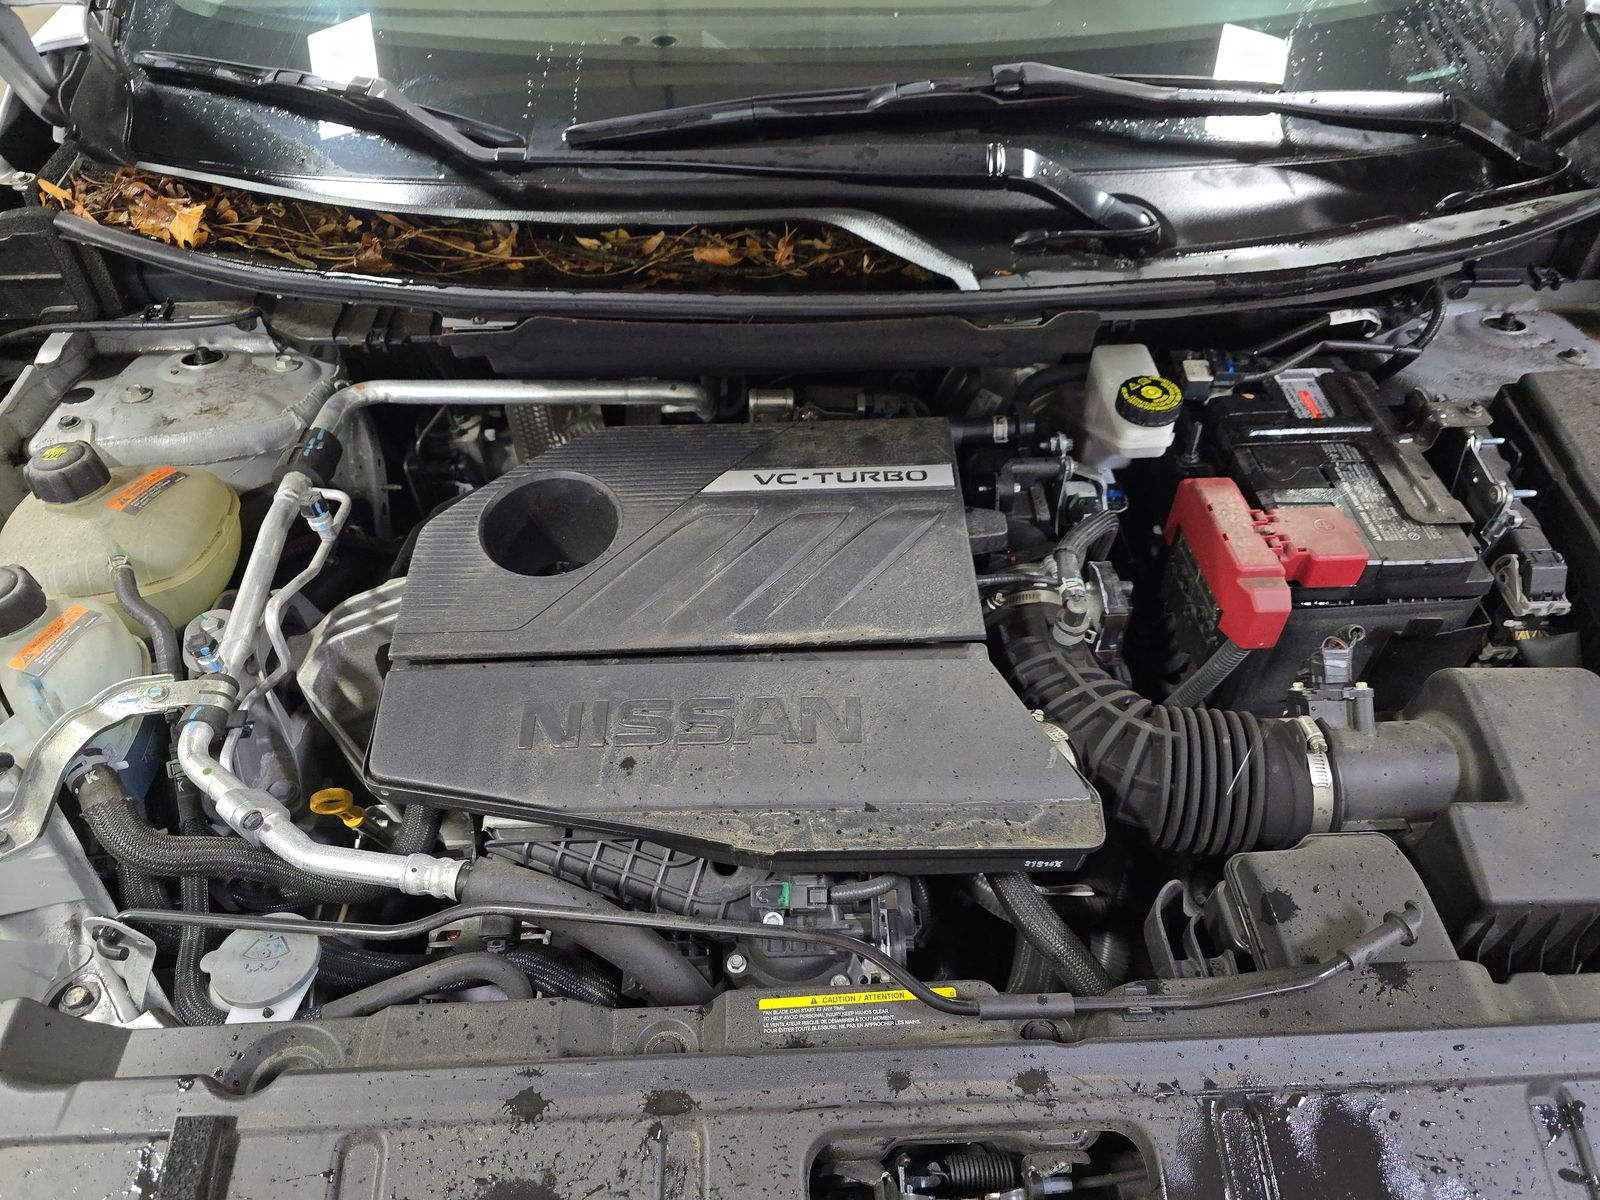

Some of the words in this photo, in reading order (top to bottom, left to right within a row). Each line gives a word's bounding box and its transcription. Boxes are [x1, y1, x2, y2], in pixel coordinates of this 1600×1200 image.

[753, 470, 929, 486] VC-TURBO
[517, 695, 862, 750] NISSAN
[85, 770, 100, 785] K
[177, 780, 185, 792] K
[822, 995, 856, 1004] CAUTION
[864, 992, 905, 1001] ATTENTION
